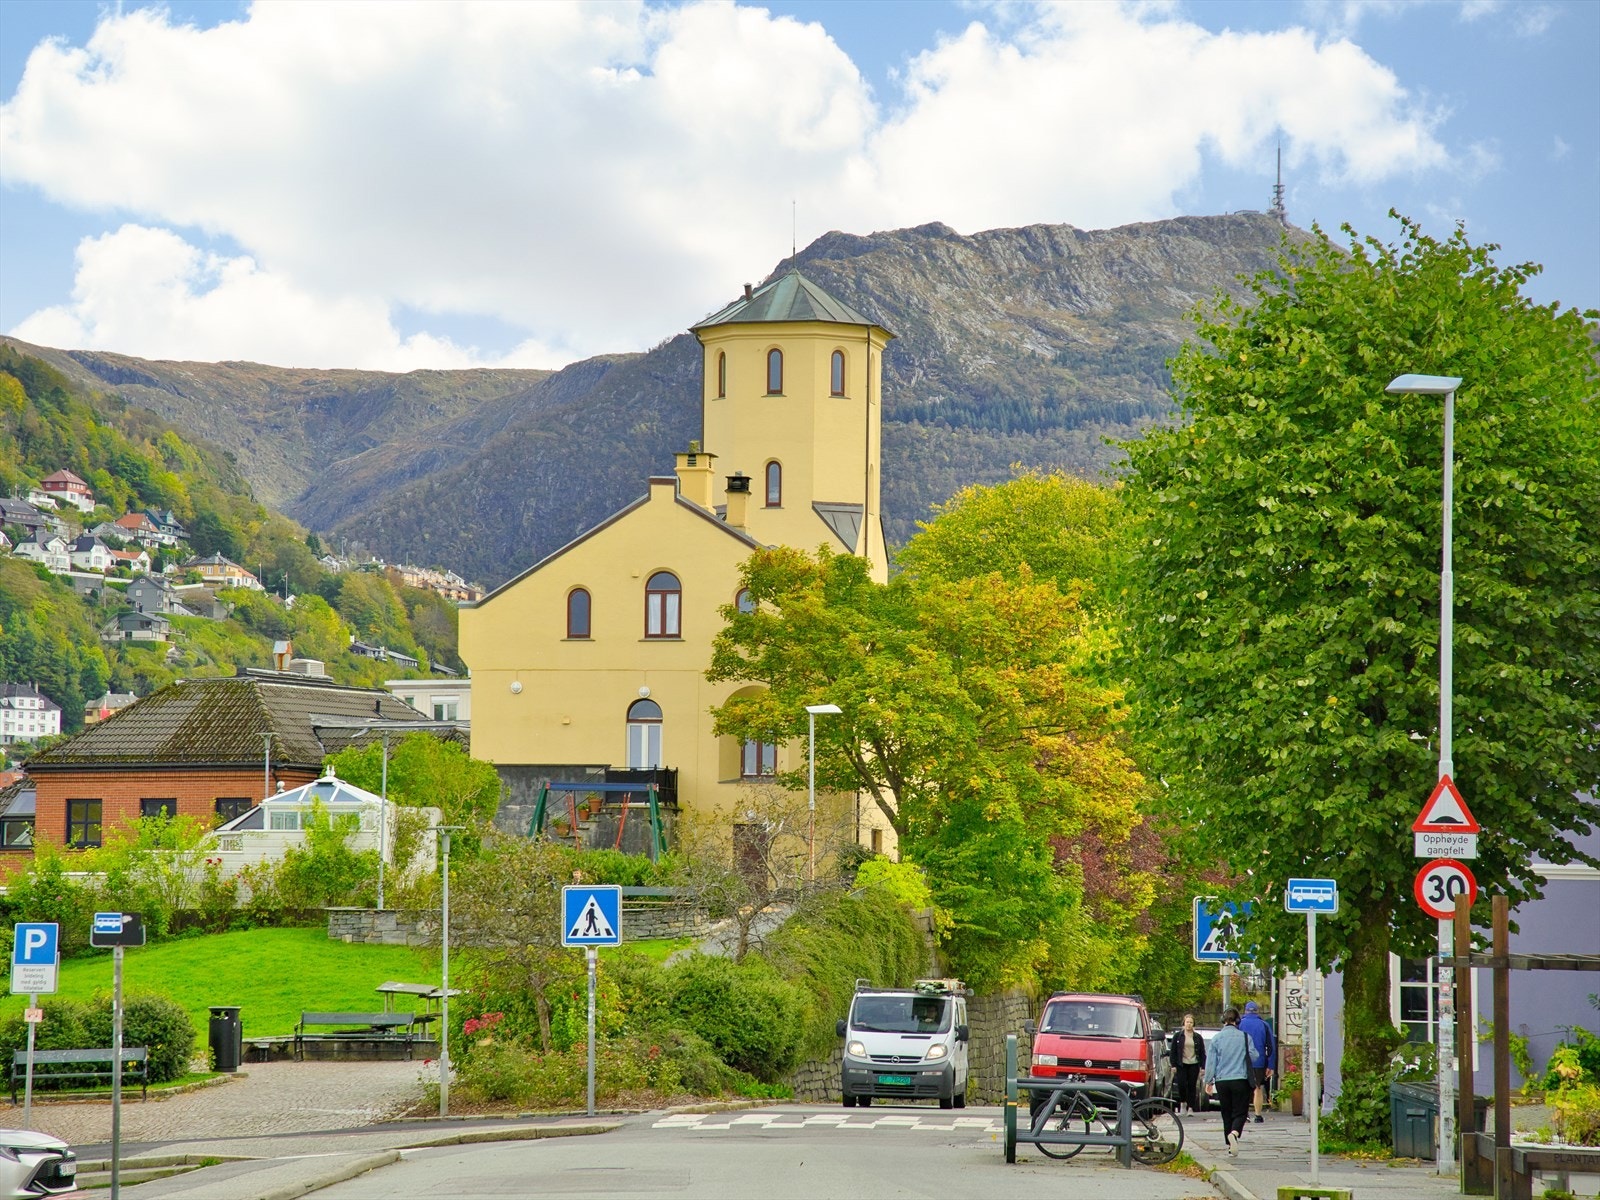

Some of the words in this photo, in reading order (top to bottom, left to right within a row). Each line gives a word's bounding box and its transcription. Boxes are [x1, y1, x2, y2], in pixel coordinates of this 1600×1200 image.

[1423, 834, 1469, 845] Opphøyde
[1427, 846, 1465, 856] gangfelt
[1428, 874, 1466, 903] 30
[24, 928, 47, 960] P
